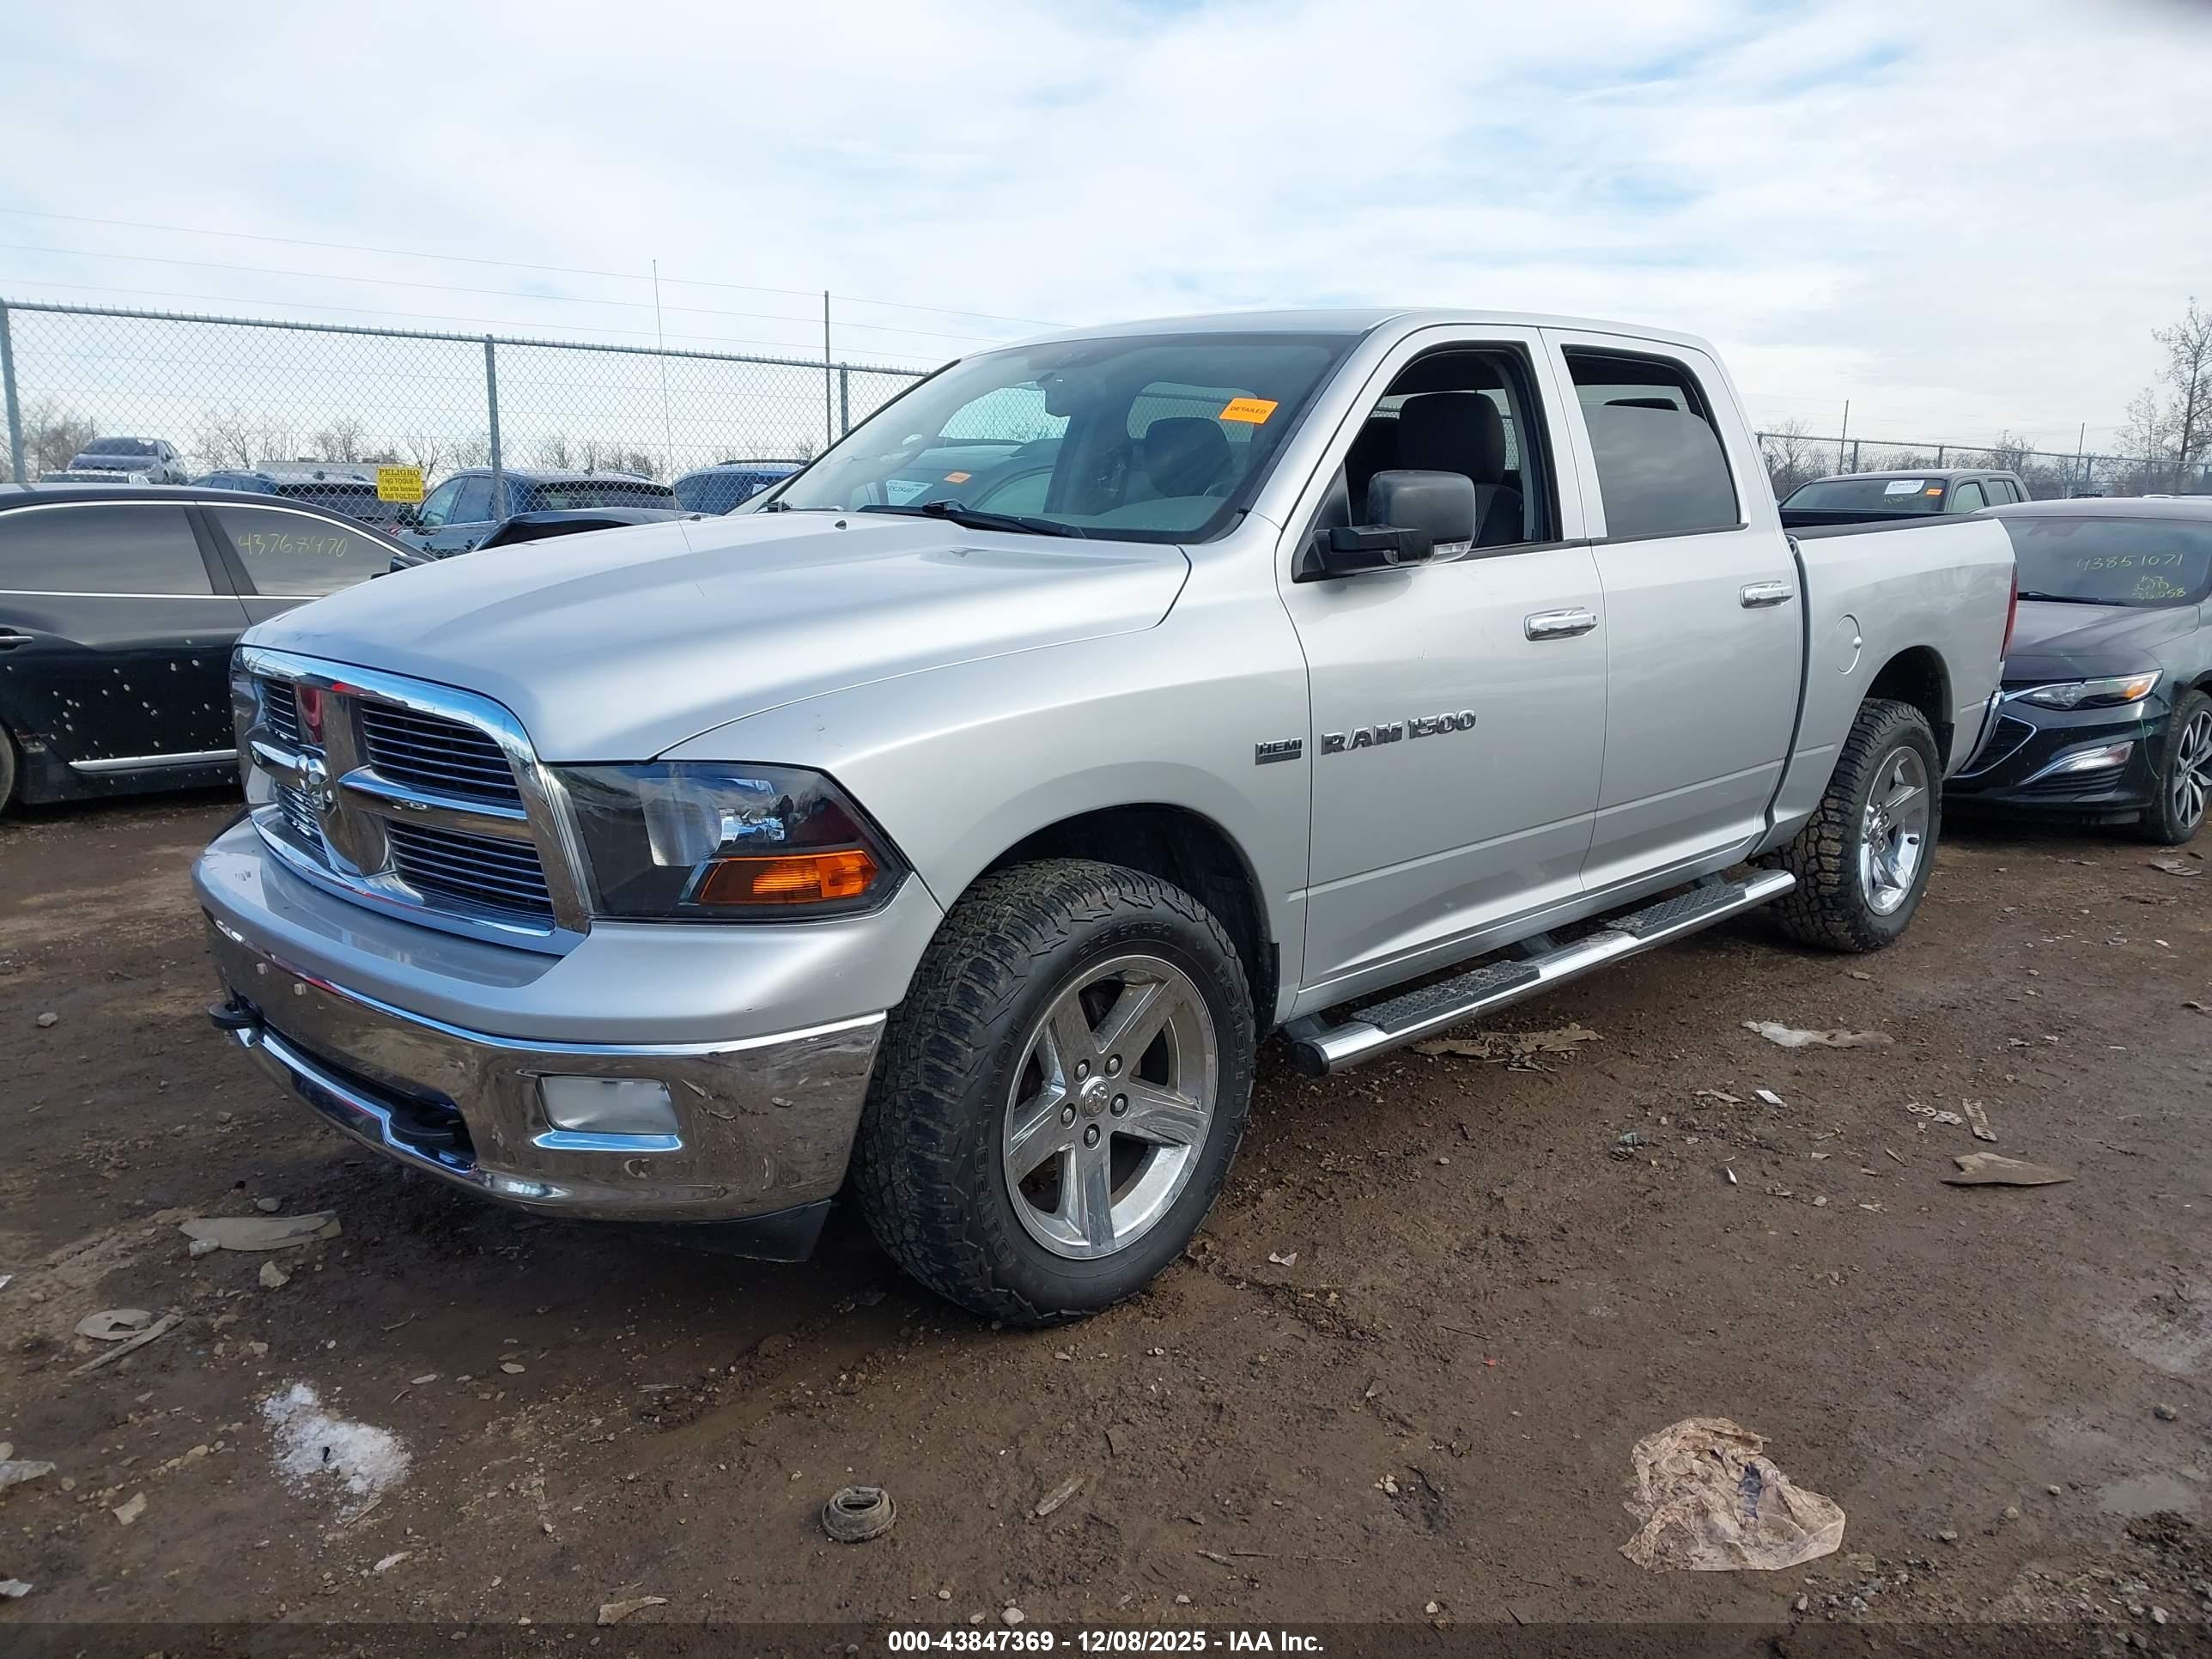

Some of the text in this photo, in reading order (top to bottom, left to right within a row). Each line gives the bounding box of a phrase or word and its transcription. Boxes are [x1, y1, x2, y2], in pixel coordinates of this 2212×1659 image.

[1257, 738, 1303, 757] HEMI
[1321, 708, 1477, 756] RAM 1500
[974, 1096, 1011, 1263] OUTPOST
